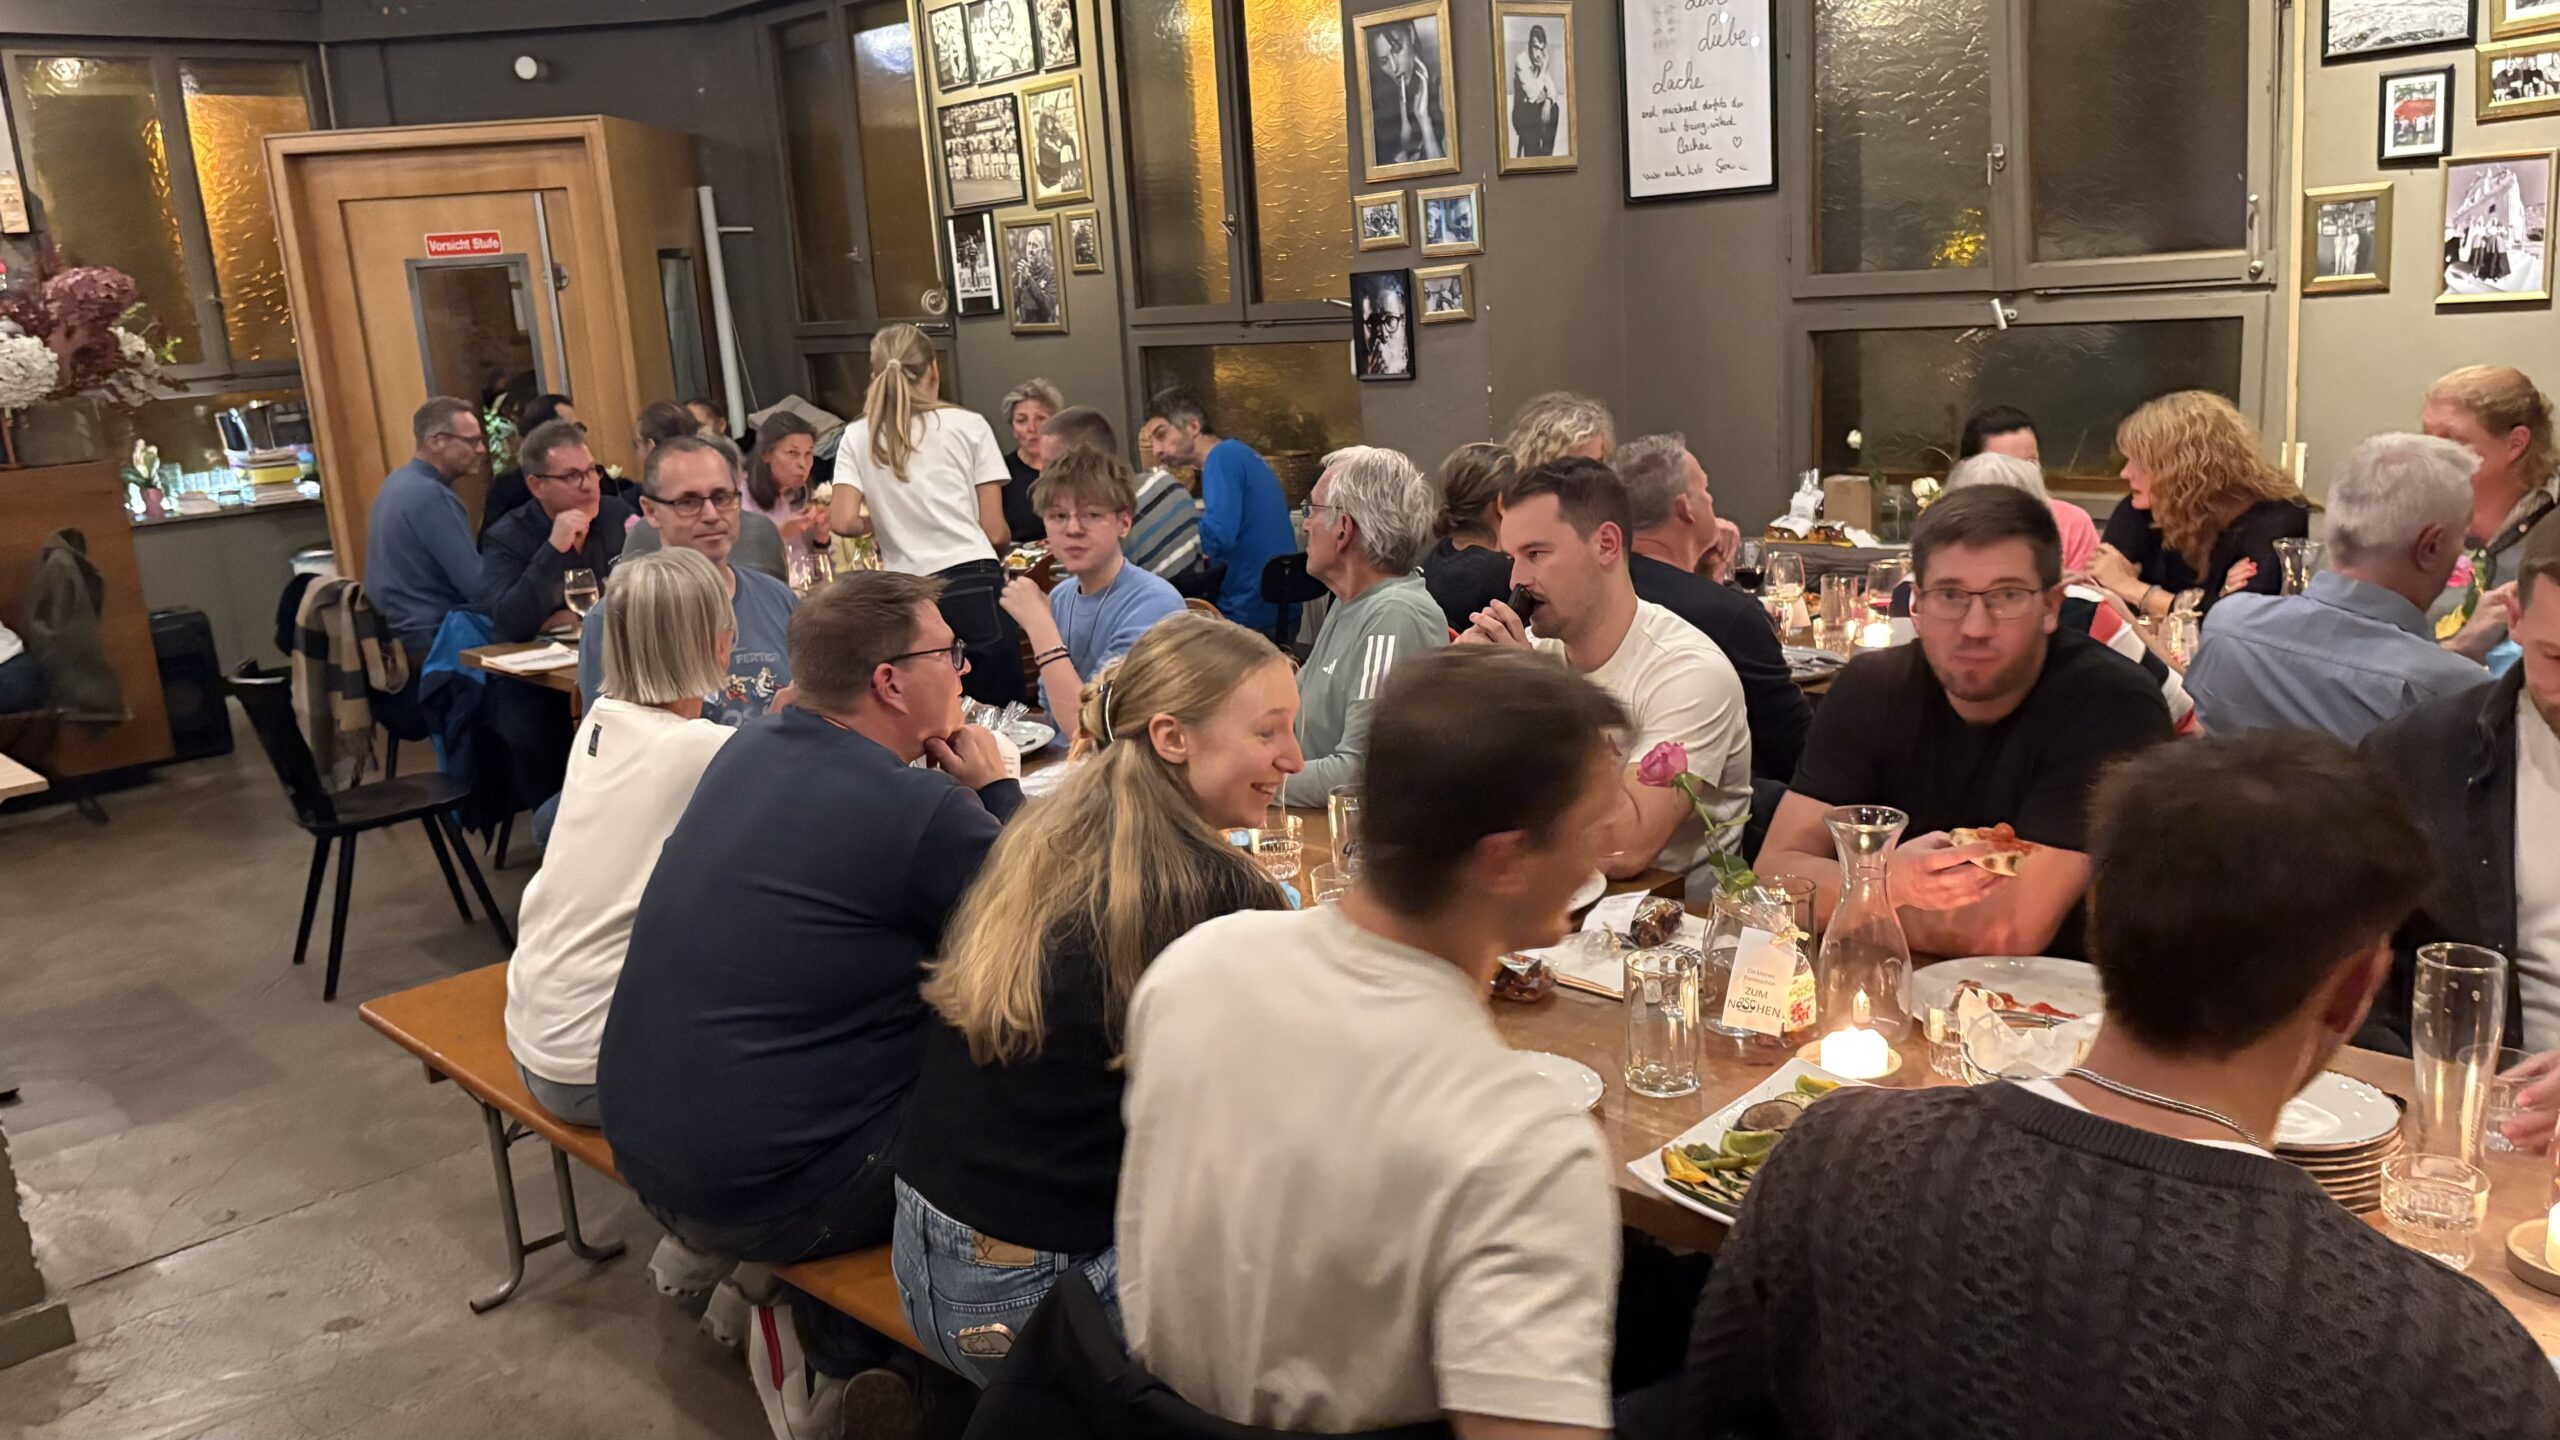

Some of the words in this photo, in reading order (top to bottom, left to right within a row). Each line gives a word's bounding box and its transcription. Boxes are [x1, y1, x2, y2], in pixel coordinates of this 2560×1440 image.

[1652, 60, 1704, 95] Lache
[428, 238, 471, 252] Vorsicht
[472, 237, 499, 250] Stufe
[1744, 986, 1768, 999] ZUM
